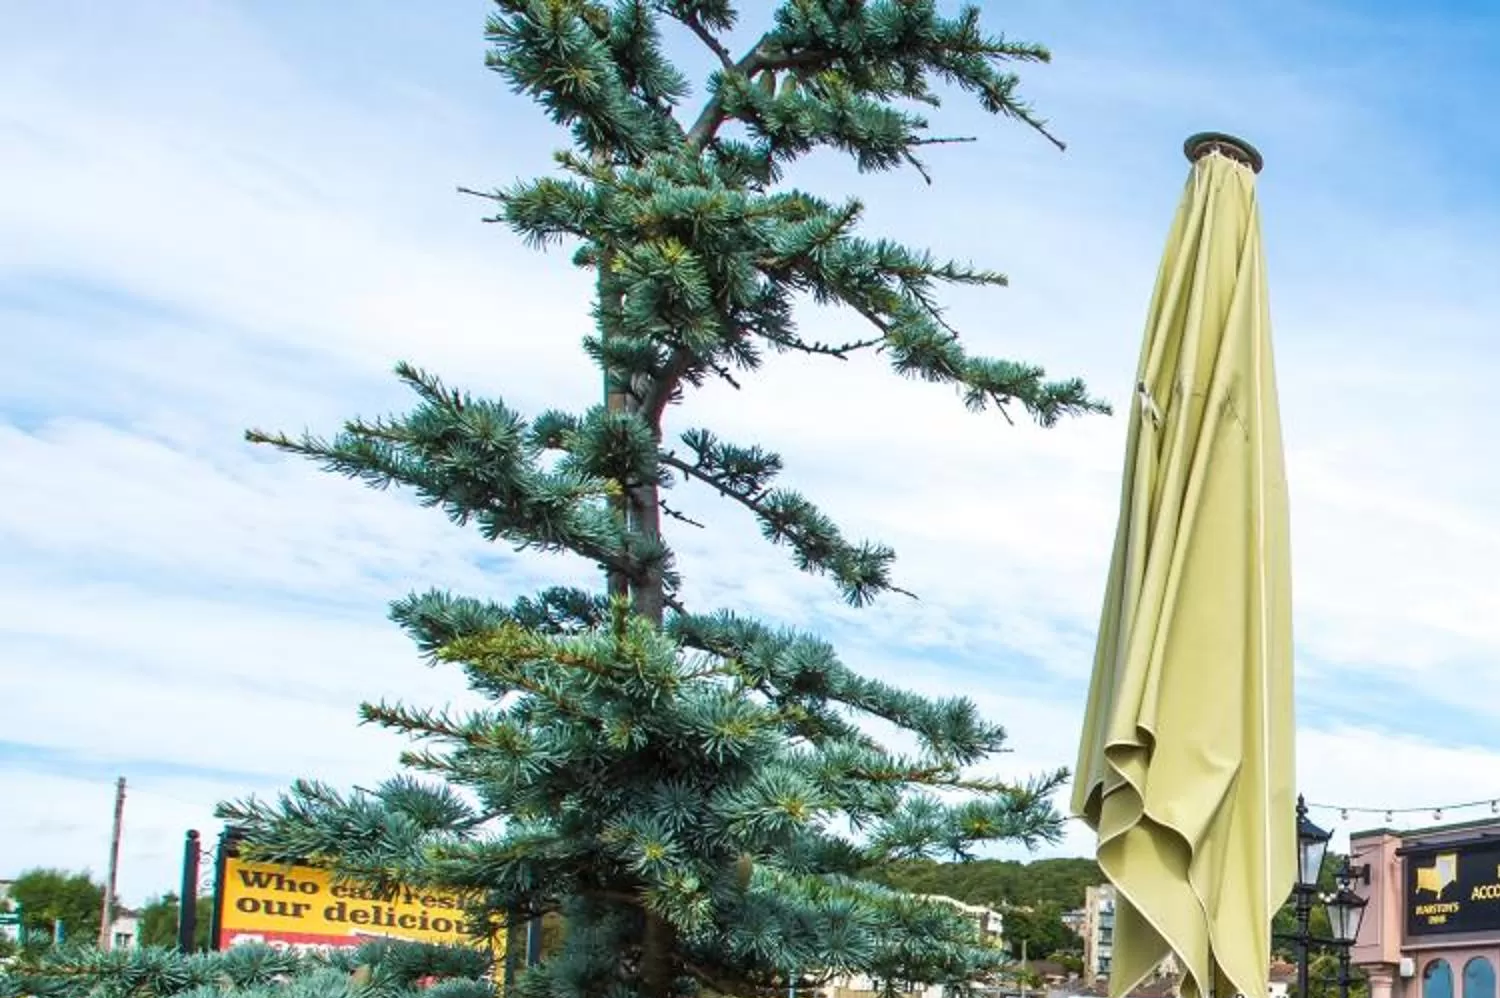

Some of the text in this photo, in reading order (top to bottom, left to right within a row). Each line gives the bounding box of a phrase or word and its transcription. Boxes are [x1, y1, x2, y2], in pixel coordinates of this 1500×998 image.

[237, 869, 320, 895] Who
[235, 895, 477, 936] our deliciou
